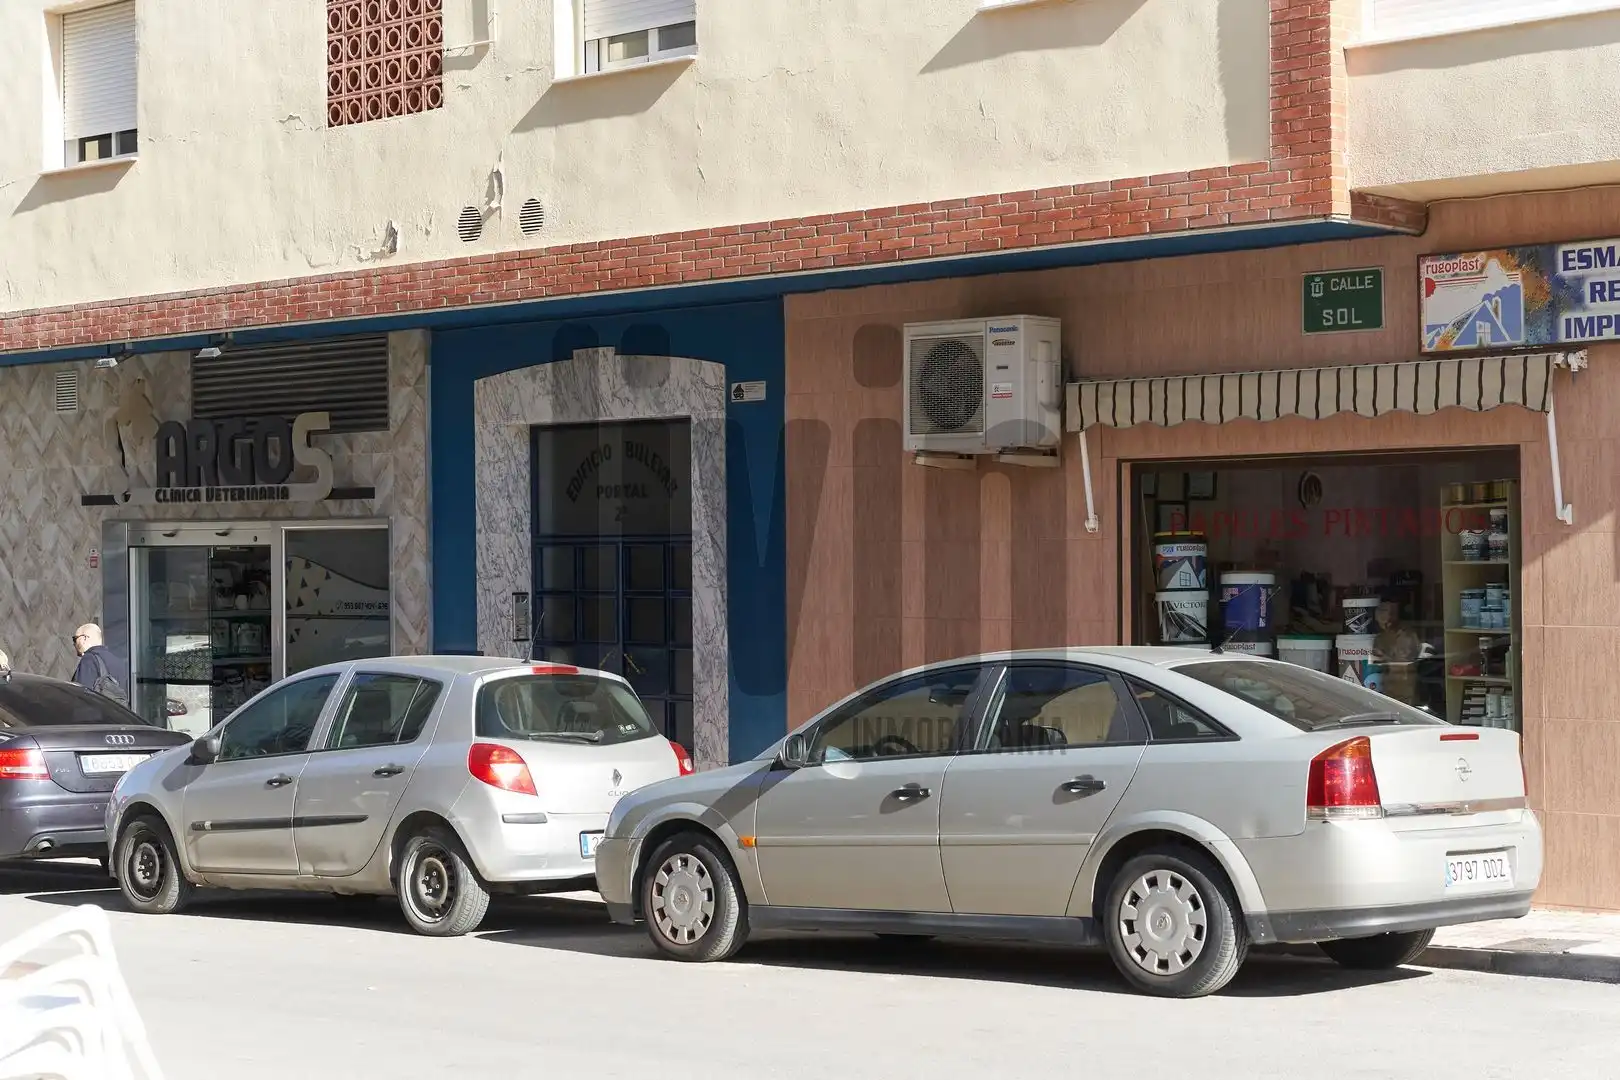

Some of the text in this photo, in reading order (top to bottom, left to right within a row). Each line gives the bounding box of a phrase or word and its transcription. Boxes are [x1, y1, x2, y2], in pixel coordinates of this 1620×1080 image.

[1426, 258, 1480, 275] rugoplast
[1562, 246, 1620, 272] ESM
[1330, 275, 1374, 292] CALLE
[1322, 307, 1363, 326] SOL
[989, 325, 1018, 334] Panasonic
[156, 411, 335, 500] ARGOS
[566, 444, 611, 503] EDIFICIO
[597, 484, 649, 498] PORTAL
[1171, 508, 1310, 538] PAPELES
[1450, 861, 1478, 881] 3797
